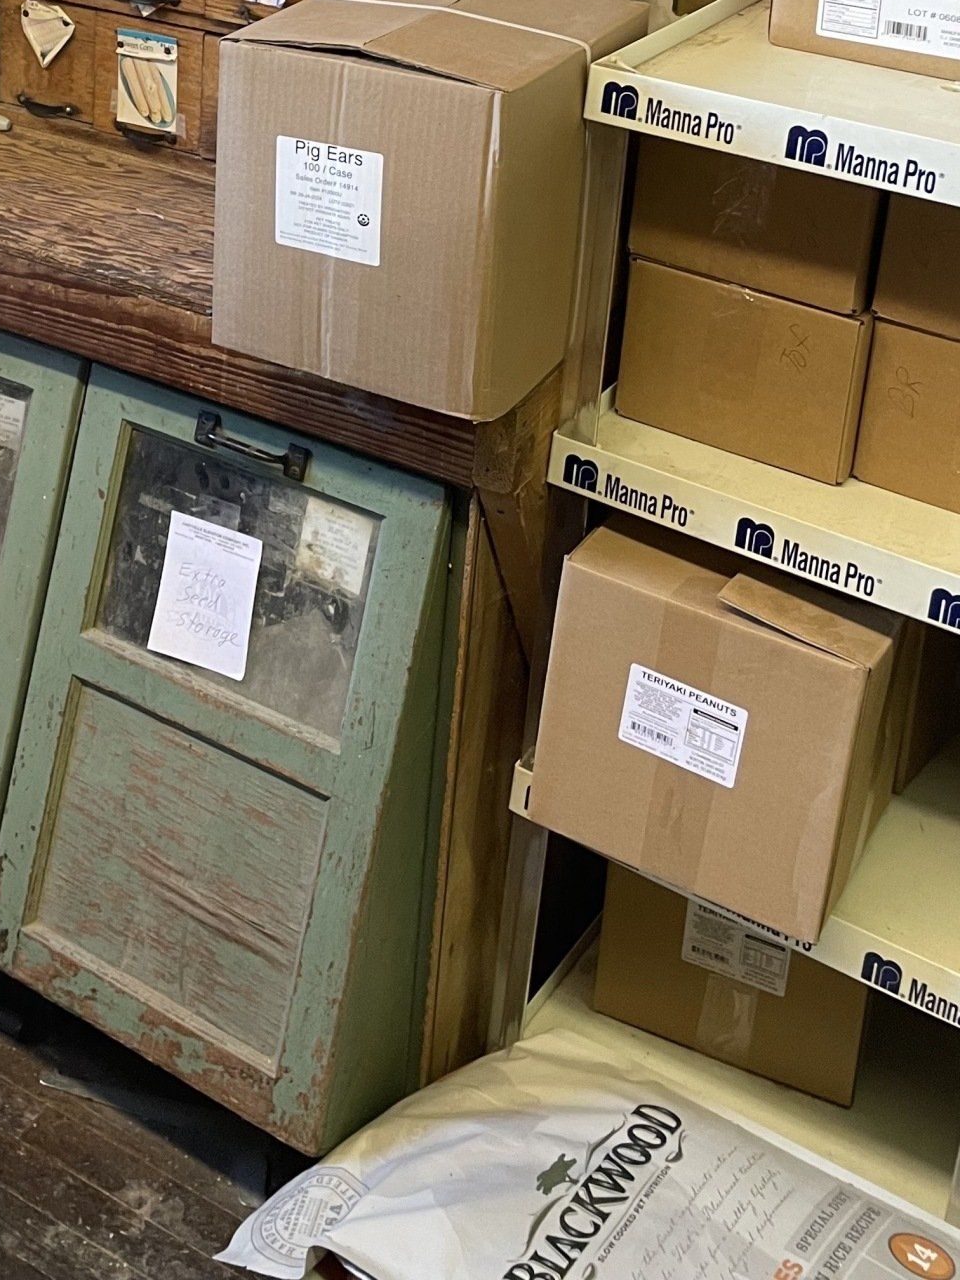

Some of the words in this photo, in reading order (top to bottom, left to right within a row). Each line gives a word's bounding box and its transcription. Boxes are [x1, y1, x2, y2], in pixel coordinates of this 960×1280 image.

[908, 8, 928, 18] LOT
[645, 97, 702, 137] Manna
[706, 112, 735, 145] Pro
[296, 140, 320, 161] Pig
[327, 146, 363, 166] Ears
[304, 162, 320, 173] 100
[329, 166, 352, 179] Case
[835, 143, 900, 185] Manna
[903, 160, 936, 195] Pro
[296, 173, 313, 183] Sales
[604, 472, 658, 516] Manna
[661, 490, 688, 528] Pro
[179, 562, 227, 589] Extra
[781, 539, 842, 583] Manna
[844, 562, 876, 598] Pro
[176, 588, 221, 611] Seed
[641, 670, 687, 696] TERIYAKI
[688, 691, 737, 717] PEANUTS
[502, 1104, 682, 1280] BLACKWOOD
[597, 1242, 616, 1264] SLOW
[612, 1212, 638, 1242] COOKED
[634, 1197, 647, 1215] PET
[645, 1164, 672, 1202] NUTRITION
[795, 1208, 834, 1254] SPECIAL
[832, 1190, 851, 1214] DIET
[823, 1241, 854, 1276] RICE
[844, 1205, 882, 1245] RECIPE
[906, 1242, 938, 1272] 14
